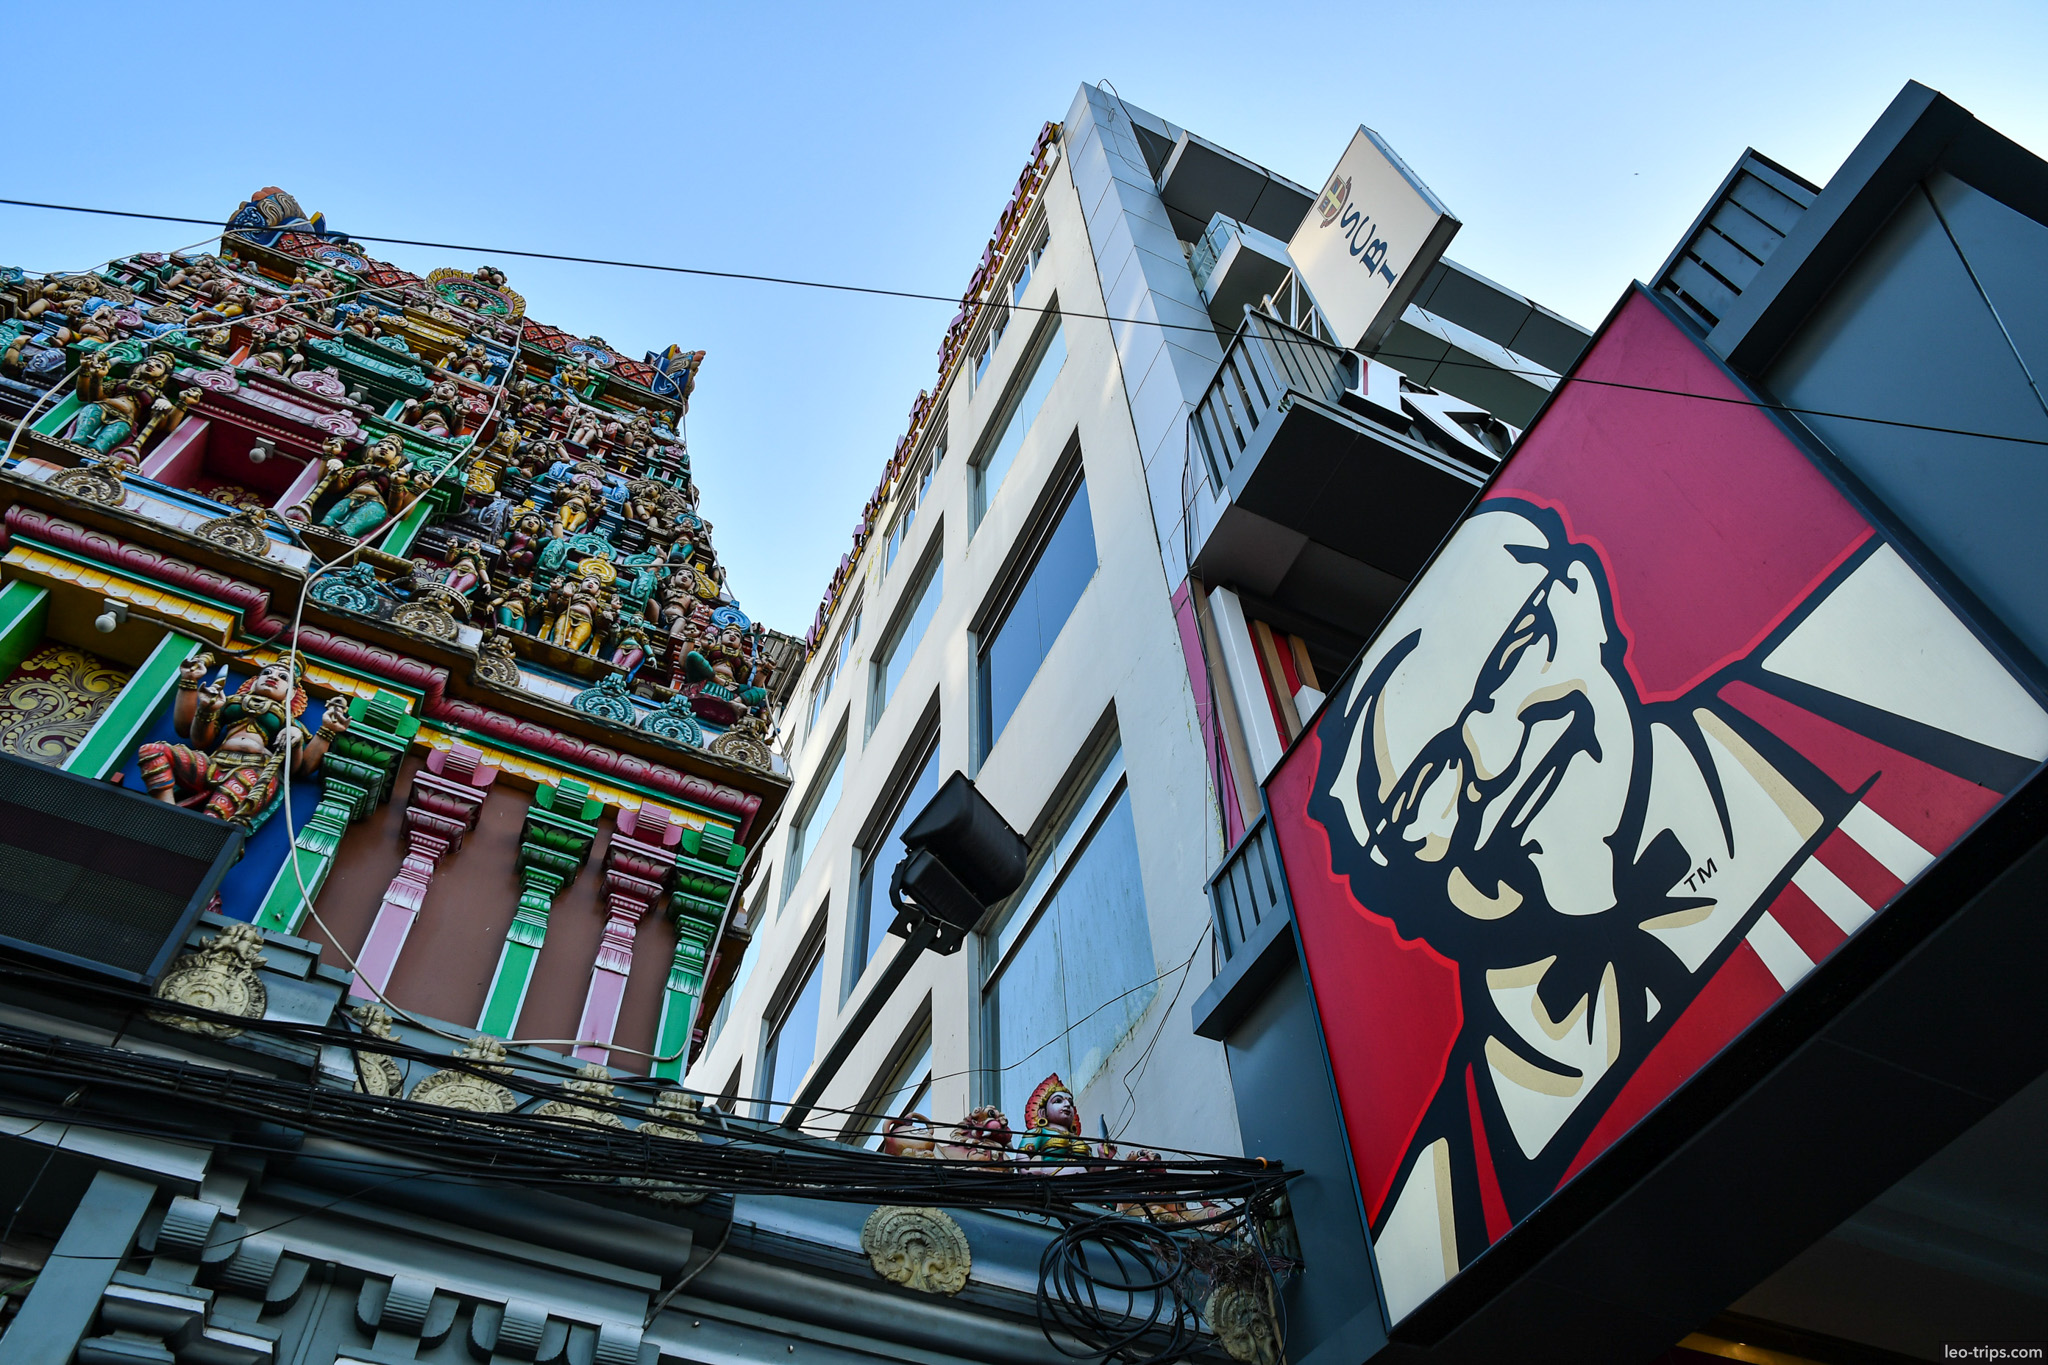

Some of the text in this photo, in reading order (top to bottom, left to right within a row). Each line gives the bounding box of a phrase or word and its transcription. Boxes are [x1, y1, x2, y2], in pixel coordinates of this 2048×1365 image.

[984, 158, 1050, 292] Journal
[1340, 202, 1398, 289] SUBI
[805, 120, 1061, 663] MYANMAR INSIDER
[1683, 857, 1718, 893] TM
